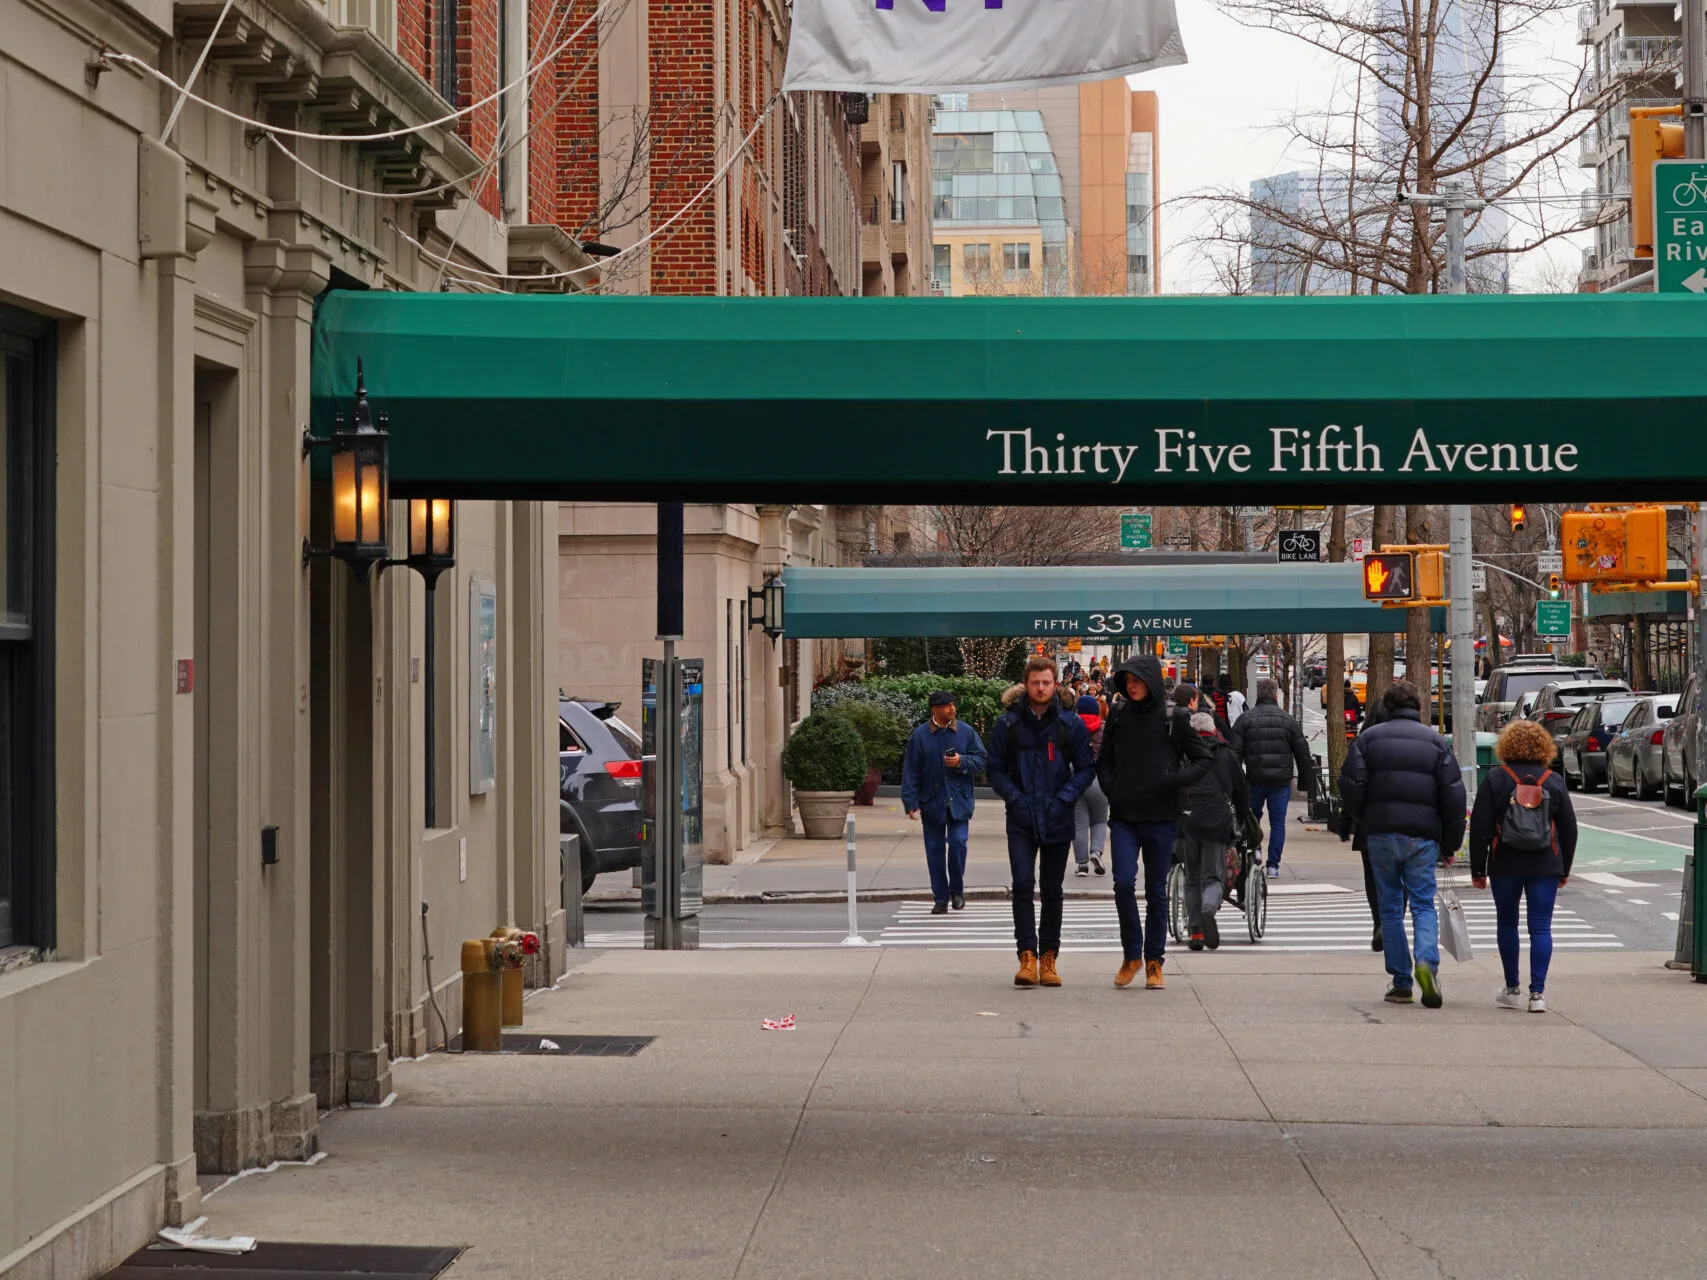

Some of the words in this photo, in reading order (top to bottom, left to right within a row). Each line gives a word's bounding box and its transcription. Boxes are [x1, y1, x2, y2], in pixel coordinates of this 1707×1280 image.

[986, 427, 1139, 484] Thirty
[1154, 428, 1251, 474] Five
[1268, 425, 1385, 474] Fifth
[1398, 427, 1579, 473] Avenue
[1281, 552, 1297, 560] BIKE
[1299, 552, 1318, 560] LANE
[1034, 619, 1078, 630] FIFTH
[1087, 614, 1125, 633] 33
[1132, 618, 1193, 629] AVENUE
